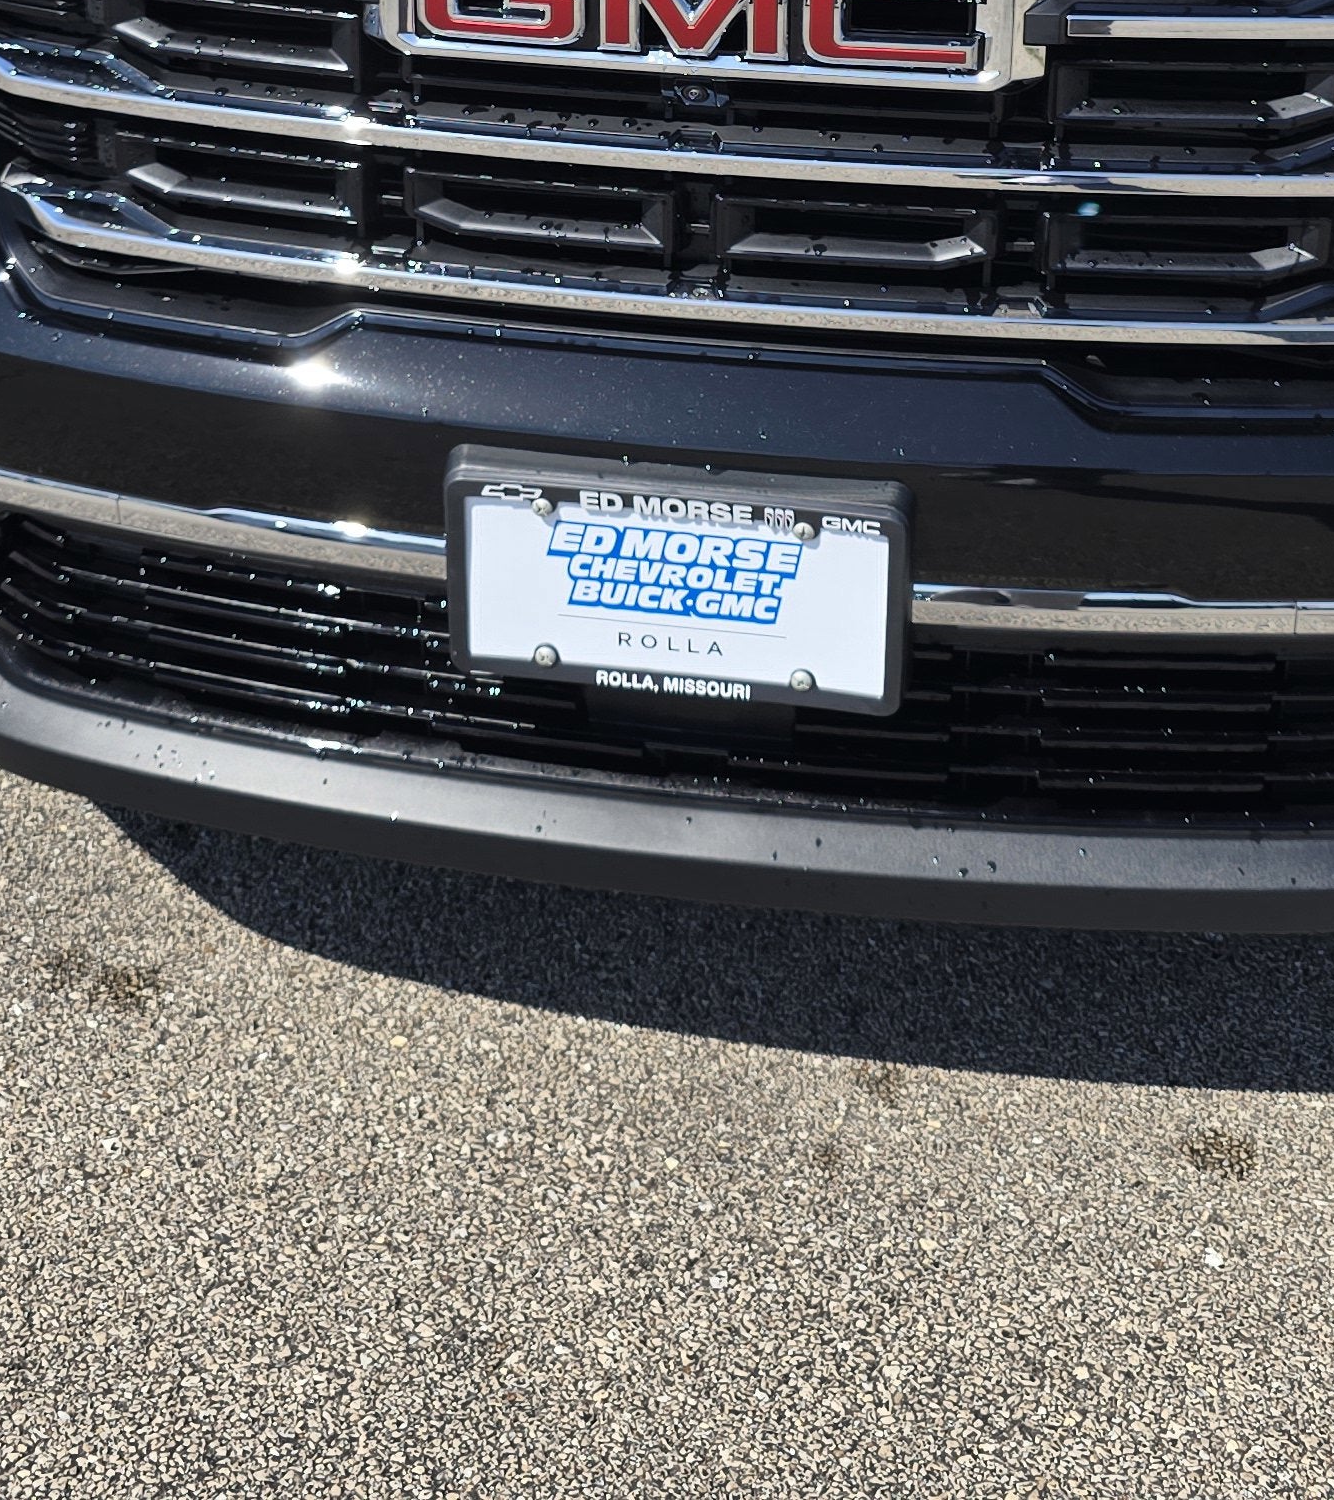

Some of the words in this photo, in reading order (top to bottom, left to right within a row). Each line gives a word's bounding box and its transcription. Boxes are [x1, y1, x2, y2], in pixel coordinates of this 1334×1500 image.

[579, 490, 624, 513] ED
[632, 495, 753, 525] MORSE
[821, 515, 881, 536] GMC
[549, 521, 618, 555] ED
[619, 527, 802, 574] MORSE
[618, 632, 723, 657] ROLLA
[595, 669, 660, 695] ROLLA,
[662, 676, 751, 702] MISSOURI
